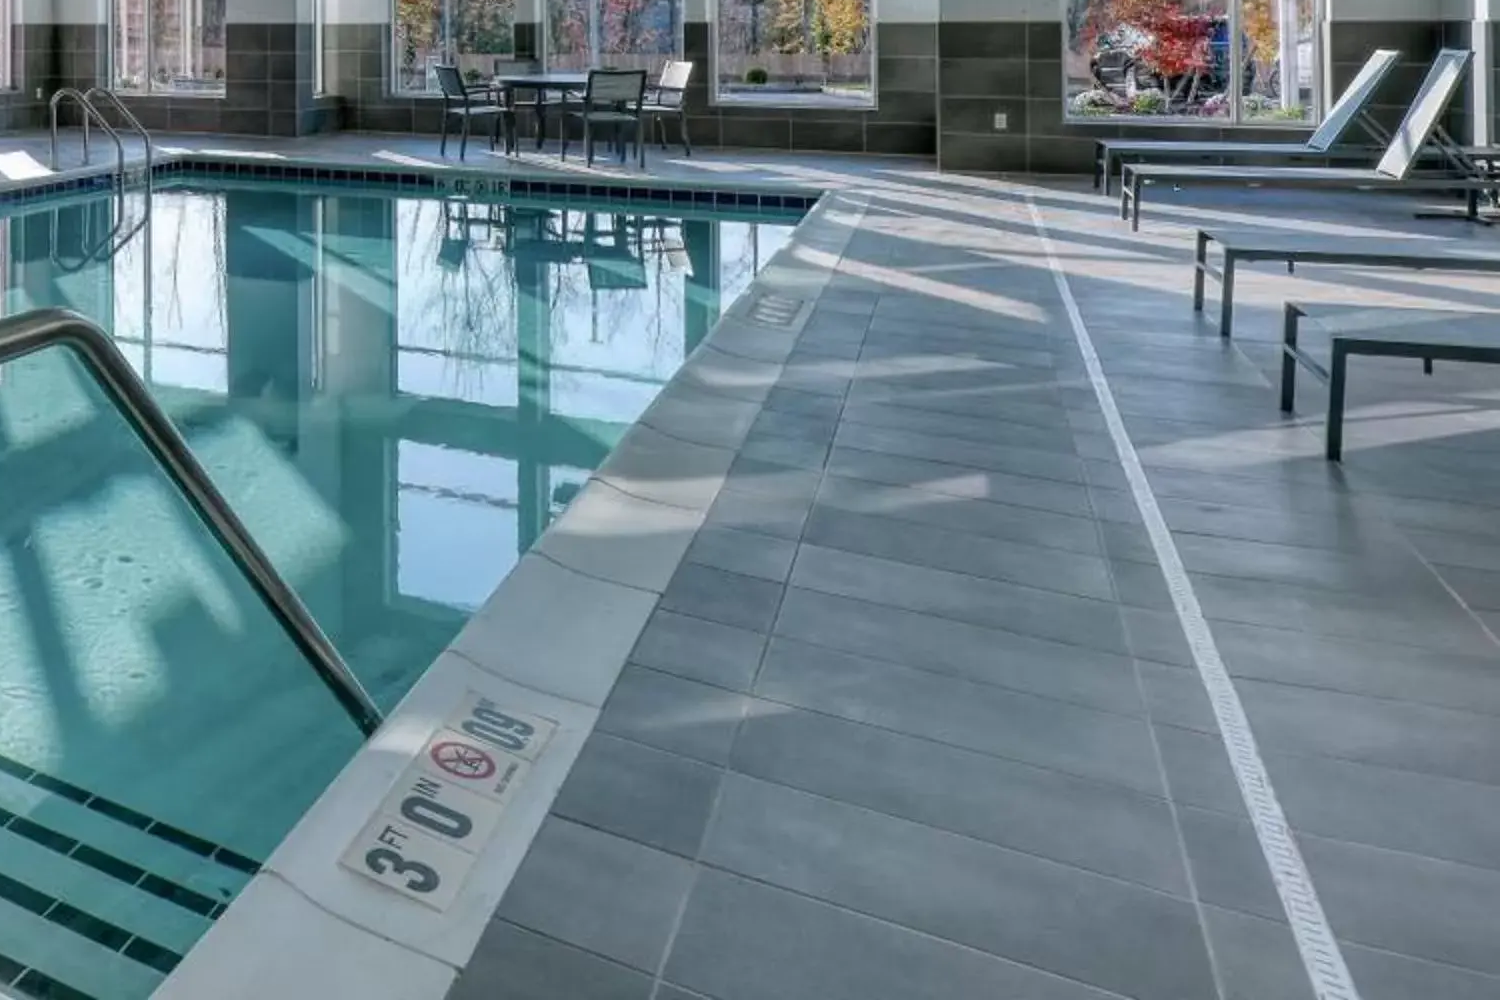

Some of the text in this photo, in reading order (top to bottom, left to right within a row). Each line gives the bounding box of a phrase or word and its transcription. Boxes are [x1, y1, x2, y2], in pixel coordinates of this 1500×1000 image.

[411, 776, 442, 798] IN
[400, 795, 473, 839] 0
[376, 823, 409, 849] FT
[364, 847, 440, 893] 3
